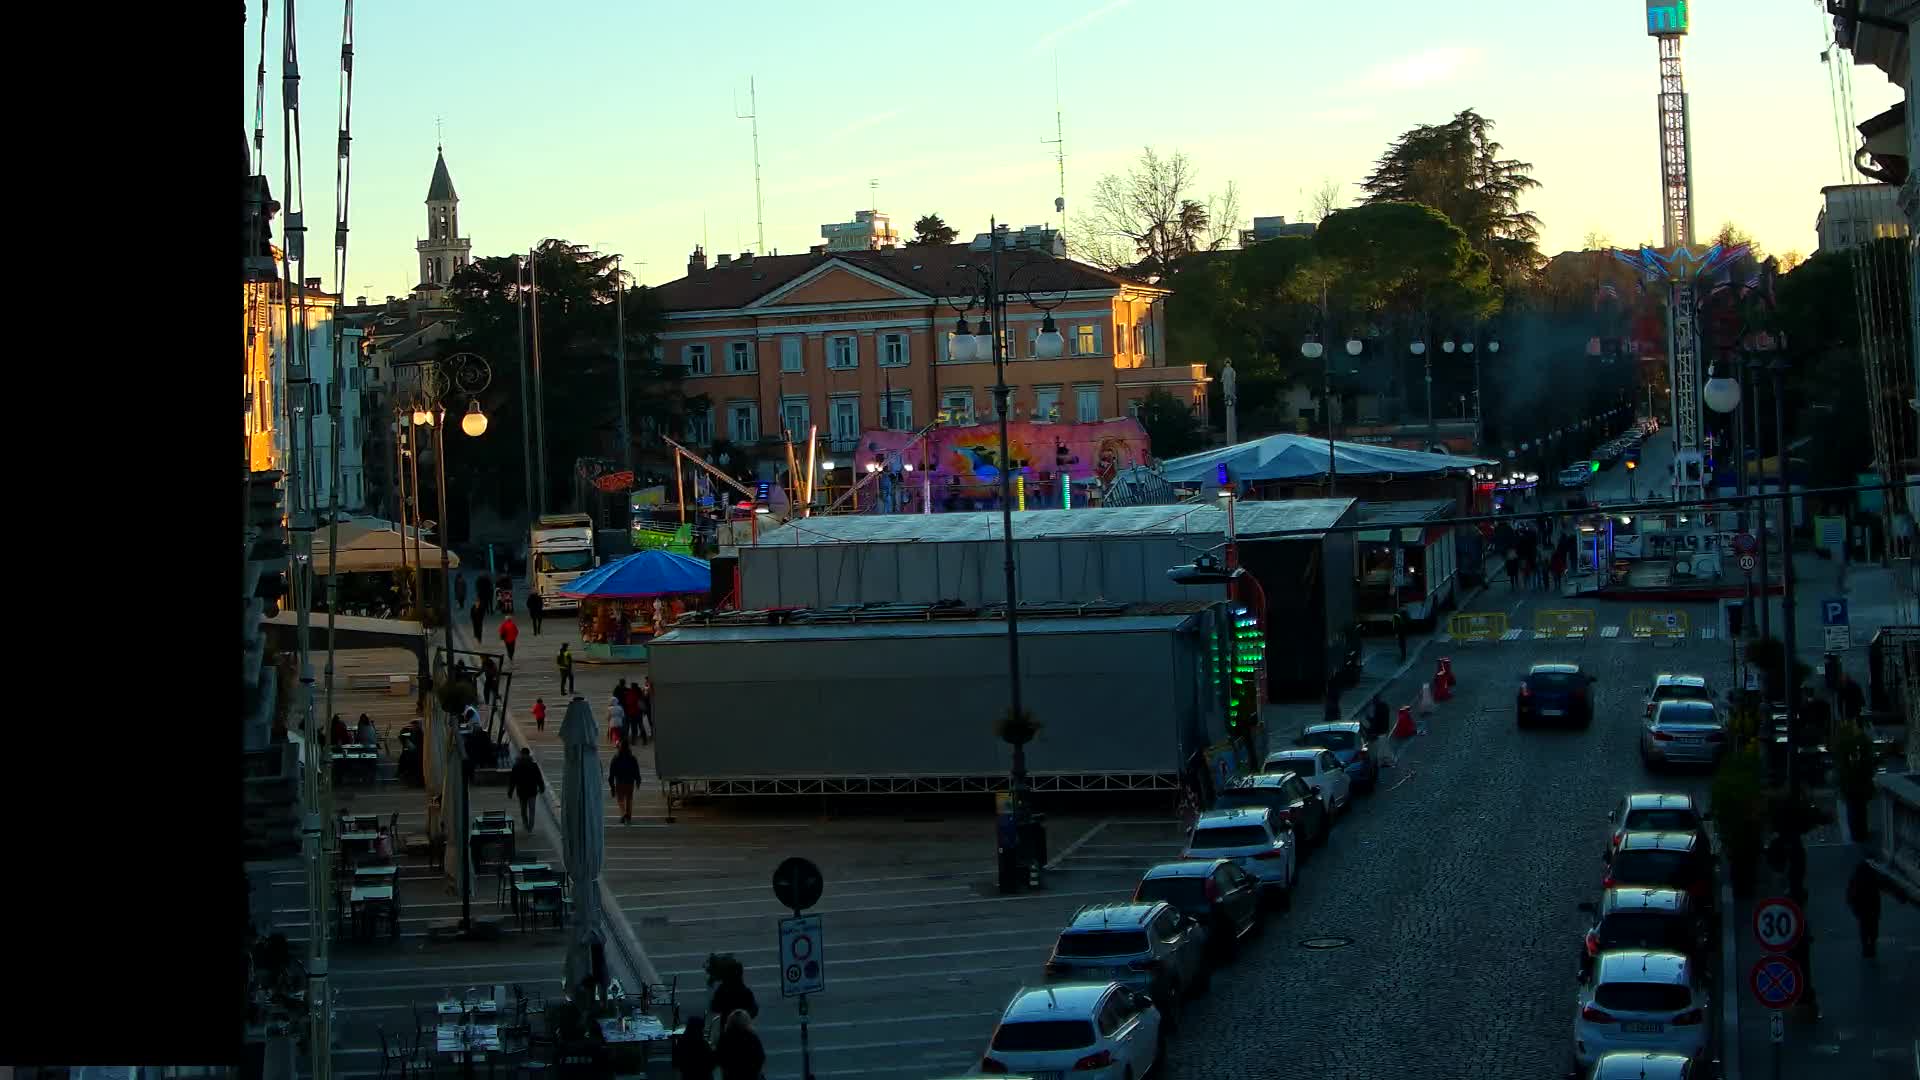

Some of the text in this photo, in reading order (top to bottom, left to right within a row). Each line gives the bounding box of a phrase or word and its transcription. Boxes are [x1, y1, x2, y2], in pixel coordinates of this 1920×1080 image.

[1742, 558, 1752, 567] 20
[1826, 603, 1842, 623] P
[1762, 912, 1791, 938] 30
